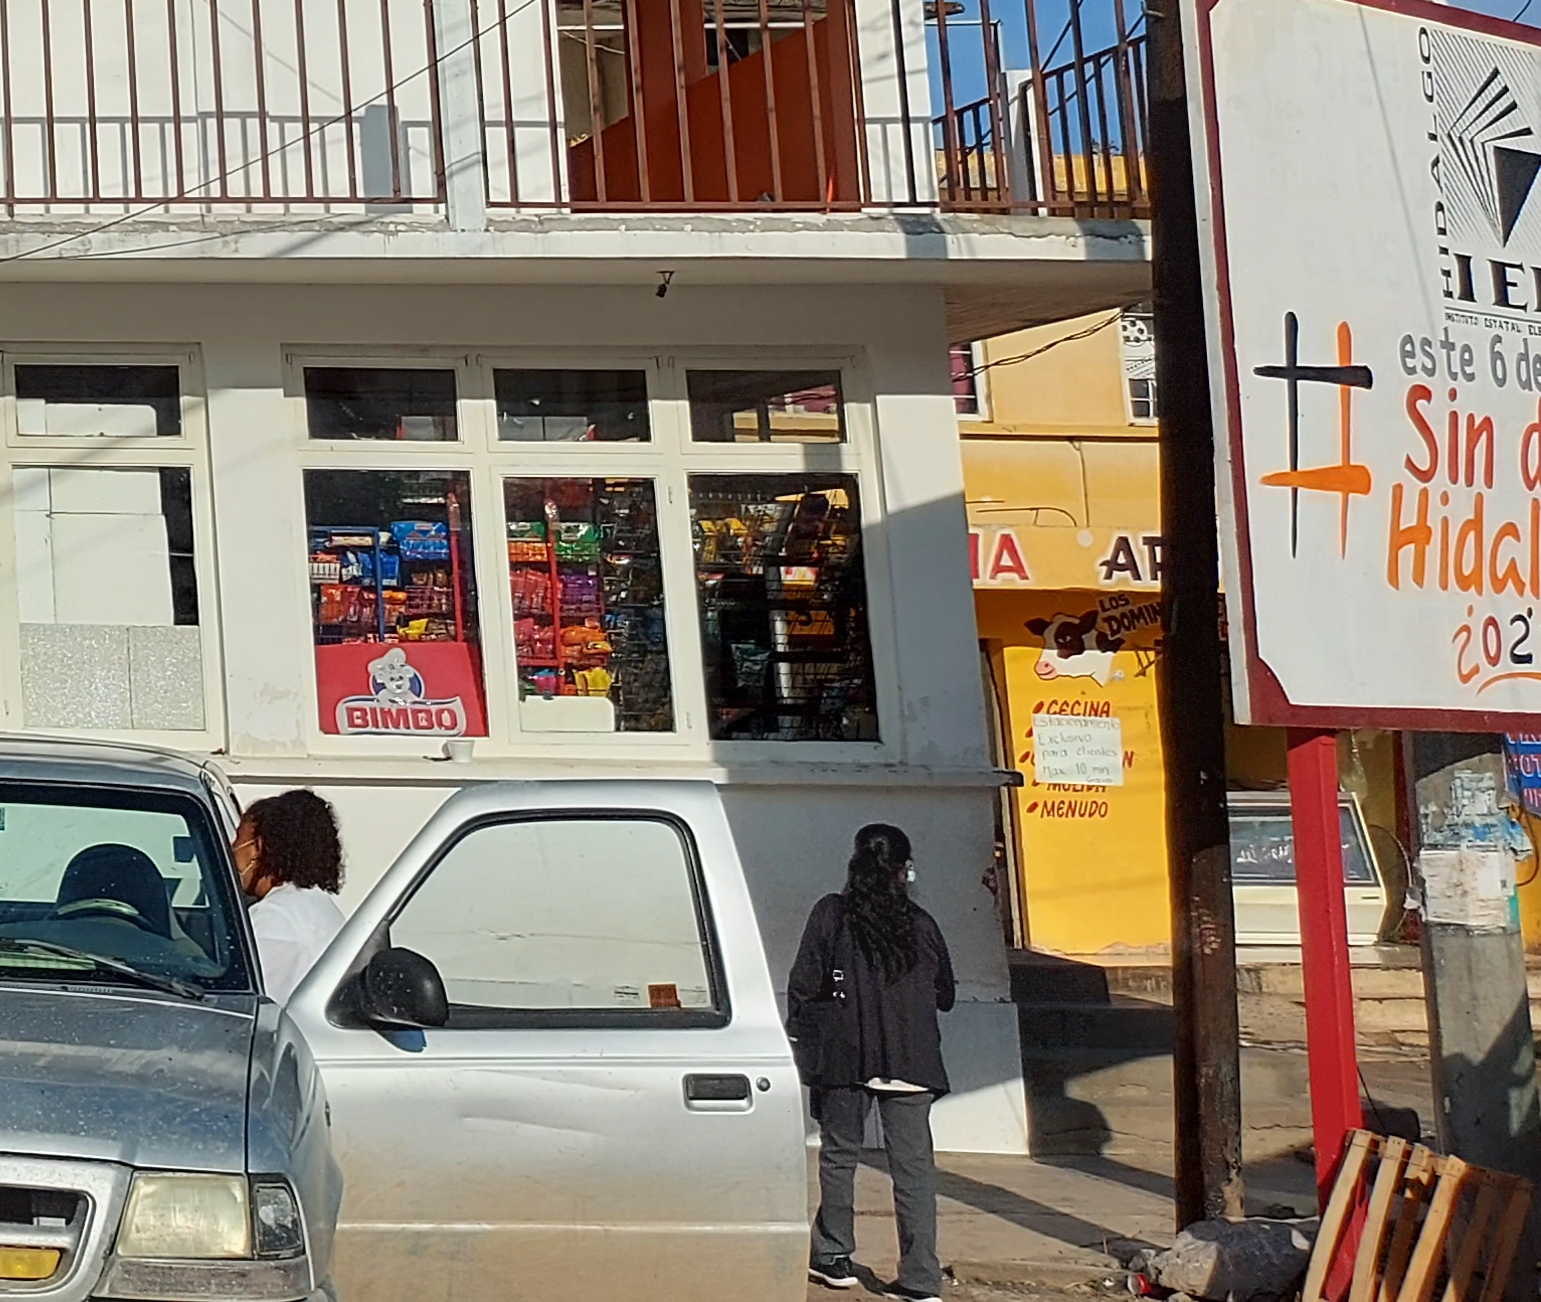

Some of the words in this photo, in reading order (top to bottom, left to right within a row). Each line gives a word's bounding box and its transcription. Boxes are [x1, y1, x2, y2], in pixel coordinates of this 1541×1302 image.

[1418, 26, 1454, 299] HIDALGO
[1453, 252, 1541, 313] IE
[1484, 317, 1522, 333] ESTATAL
[1399, 325, 1476, 382] este
[1489, 333, 1507, 388] 6
[1404, 383, 1495, 490] Sin
[1387, 482, 1541, 600] Hidal
[1098, 593, 1131, 612] LOS
[345, 706, 458, 731] BIMBO
[1046, 699, 1112, 717] CECINA
[1040, 800, 1109, 818] MENUDO
